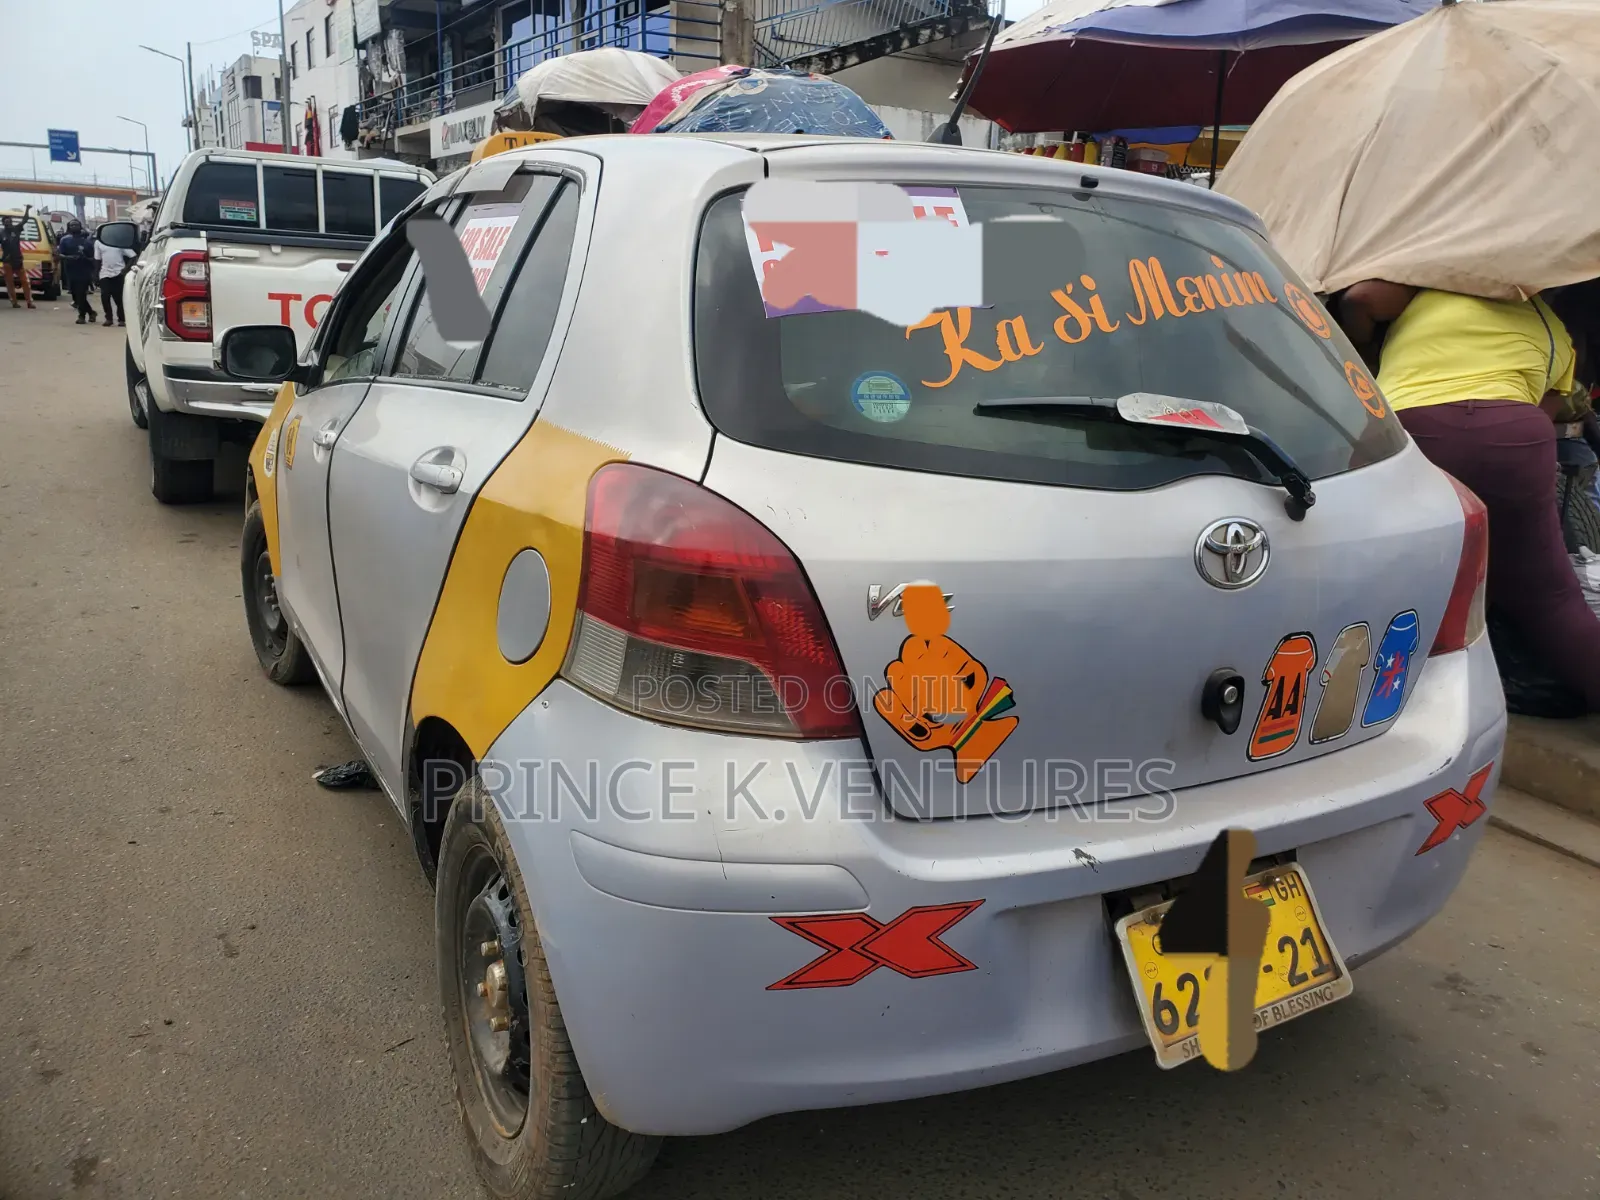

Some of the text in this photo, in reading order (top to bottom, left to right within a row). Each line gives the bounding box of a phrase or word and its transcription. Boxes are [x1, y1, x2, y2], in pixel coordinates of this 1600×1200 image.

[472, 226, 512, 260] SALE
[1275, 873, 1302, 902] GH
[1271, 985, 1334, 1023] BLESSING
